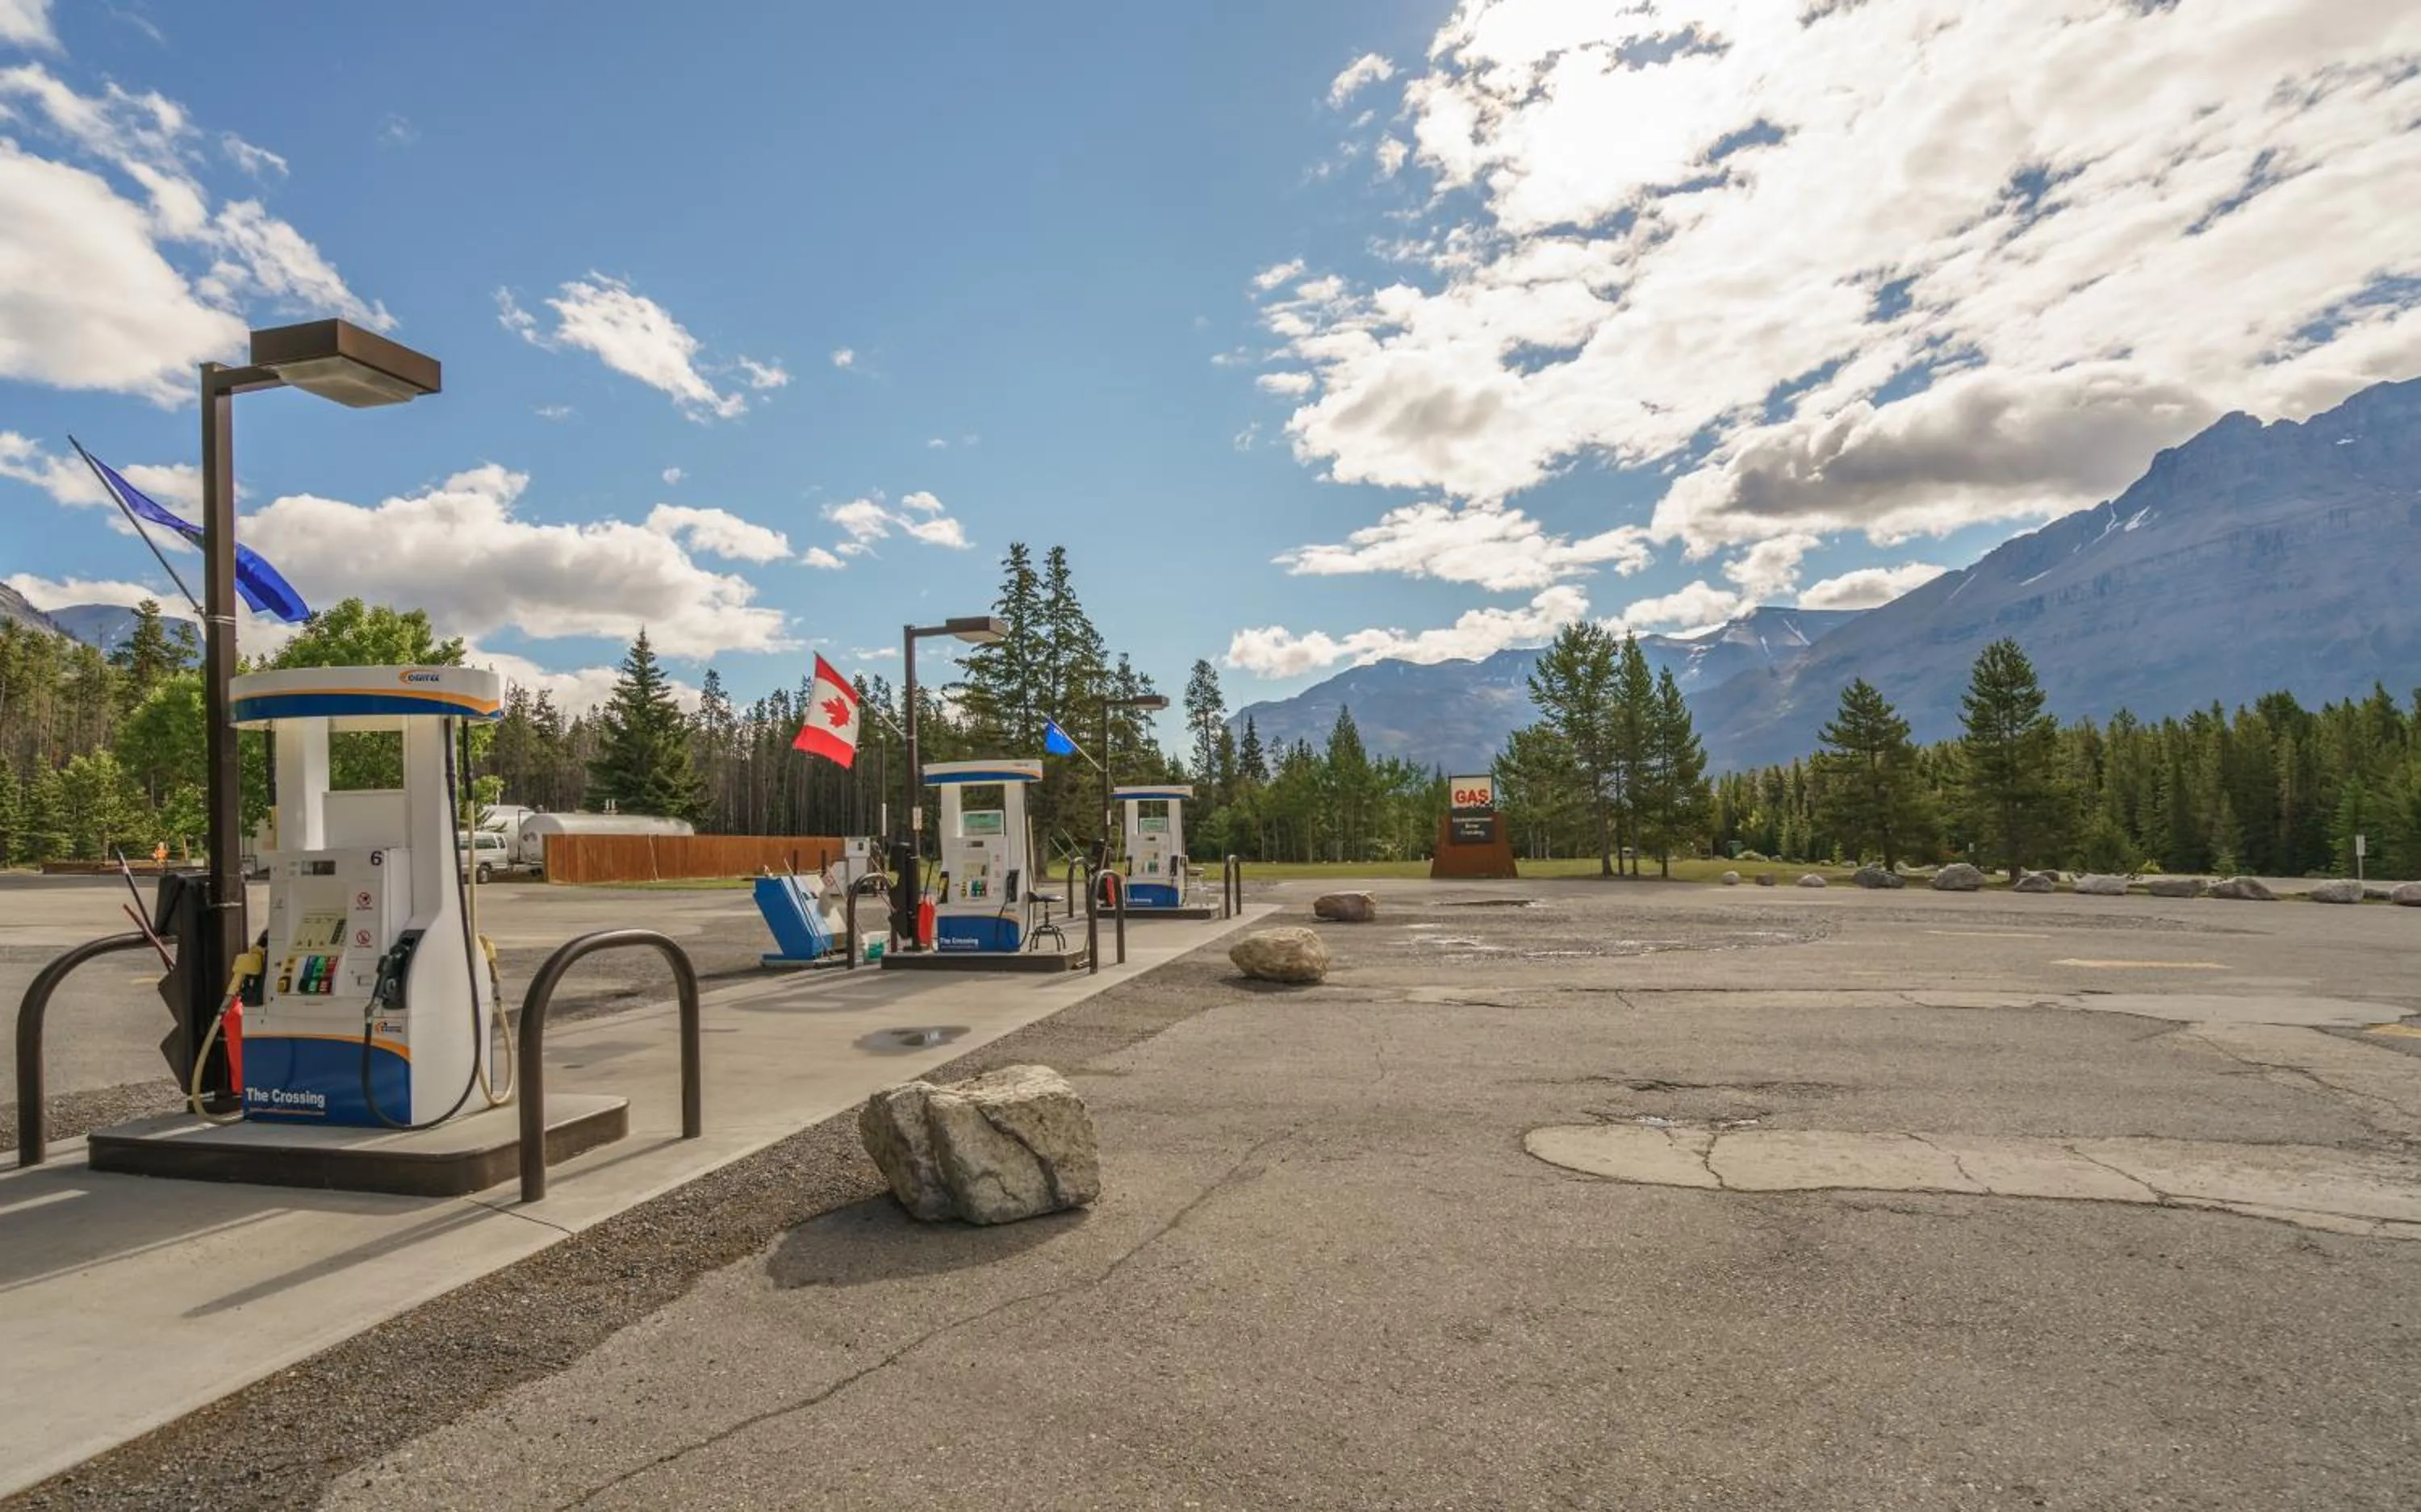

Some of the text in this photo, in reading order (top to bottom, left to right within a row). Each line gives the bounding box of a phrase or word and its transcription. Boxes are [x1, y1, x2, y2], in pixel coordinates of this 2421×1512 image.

[1455, 788, 1489, 804] GAS
[370, 850, 383, 866] 6
[246, 1087, 326, 1109] The Crossing
